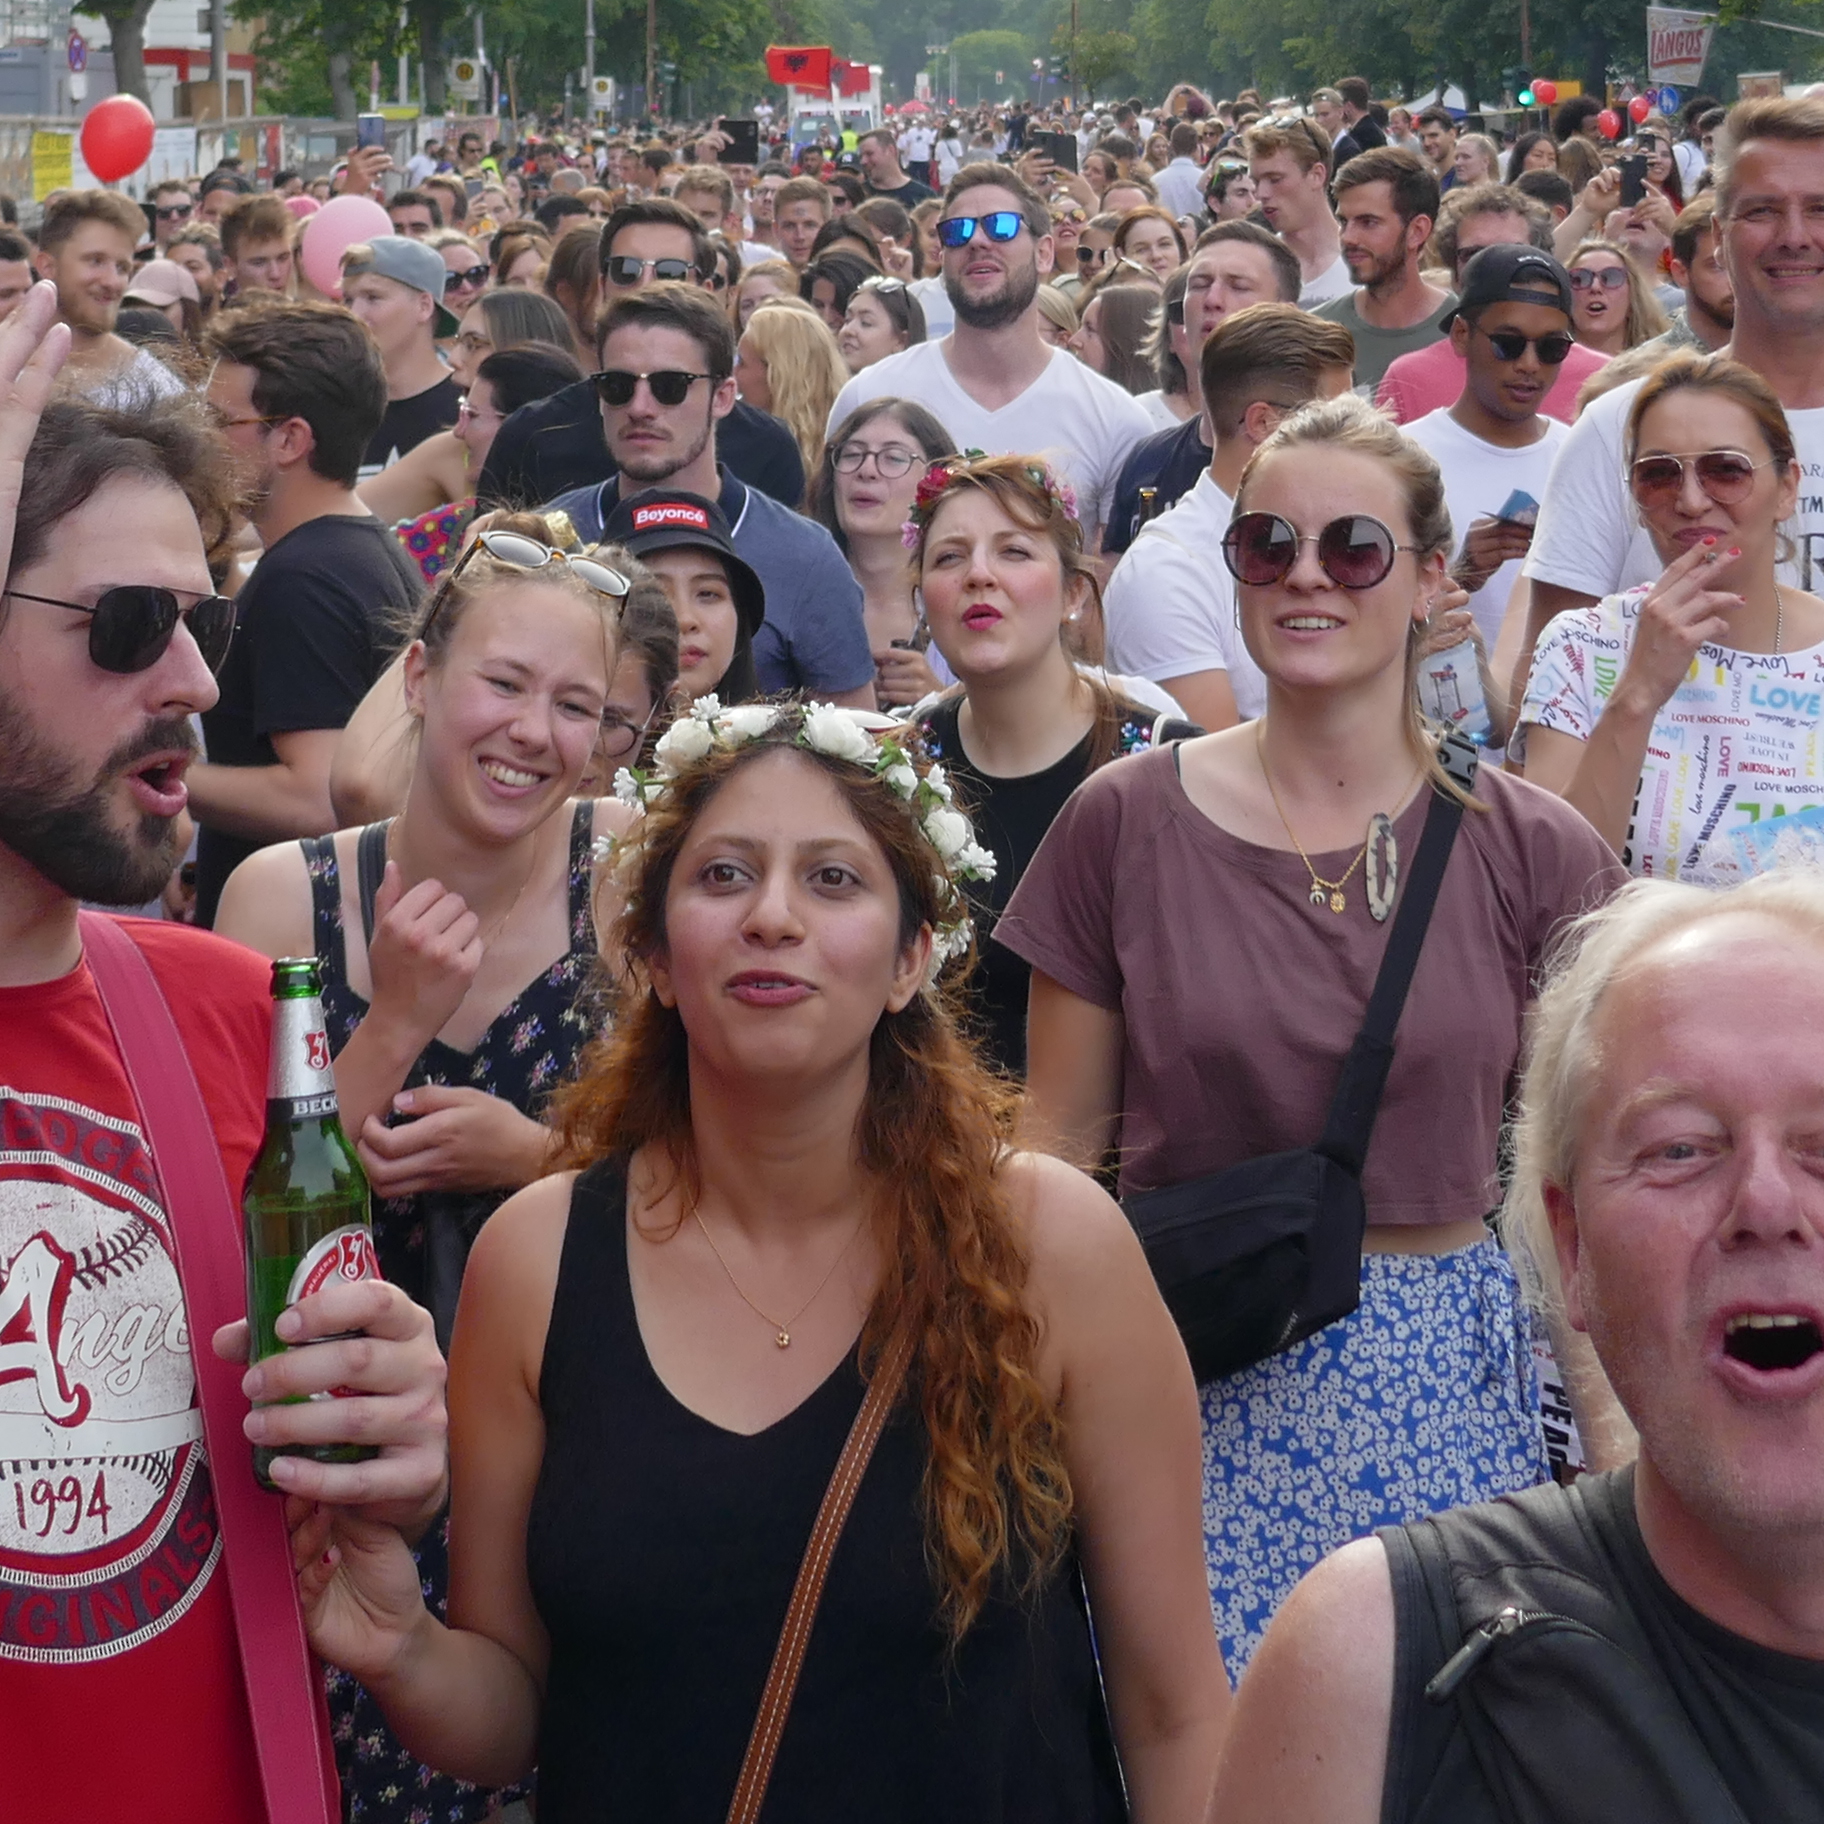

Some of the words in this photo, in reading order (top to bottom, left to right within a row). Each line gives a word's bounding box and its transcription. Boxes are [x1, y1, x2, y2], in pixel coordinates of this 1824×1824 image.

[636, 508, 705, 524] Beyoncé
[1749, 683, 1822, 717] LOVE
[1671, 712, 1695, 724] LOVE
[1696, 714, 1751, 727] MOSCHINO
[1742, 731, 1778, 747] TRUST
[1647, 746, 1671, 761] HINO
[1717, 735, 1733, 778] LOVE
[1748, 745, 1777, 760] LOVE
[1754, 780, 1783, 793] LOVE
[1697, 783, 1738, 842] MOSCHINO
[292, 1095, 338, 1116] BECK
[14, 1469, 113, 1538] 1994
